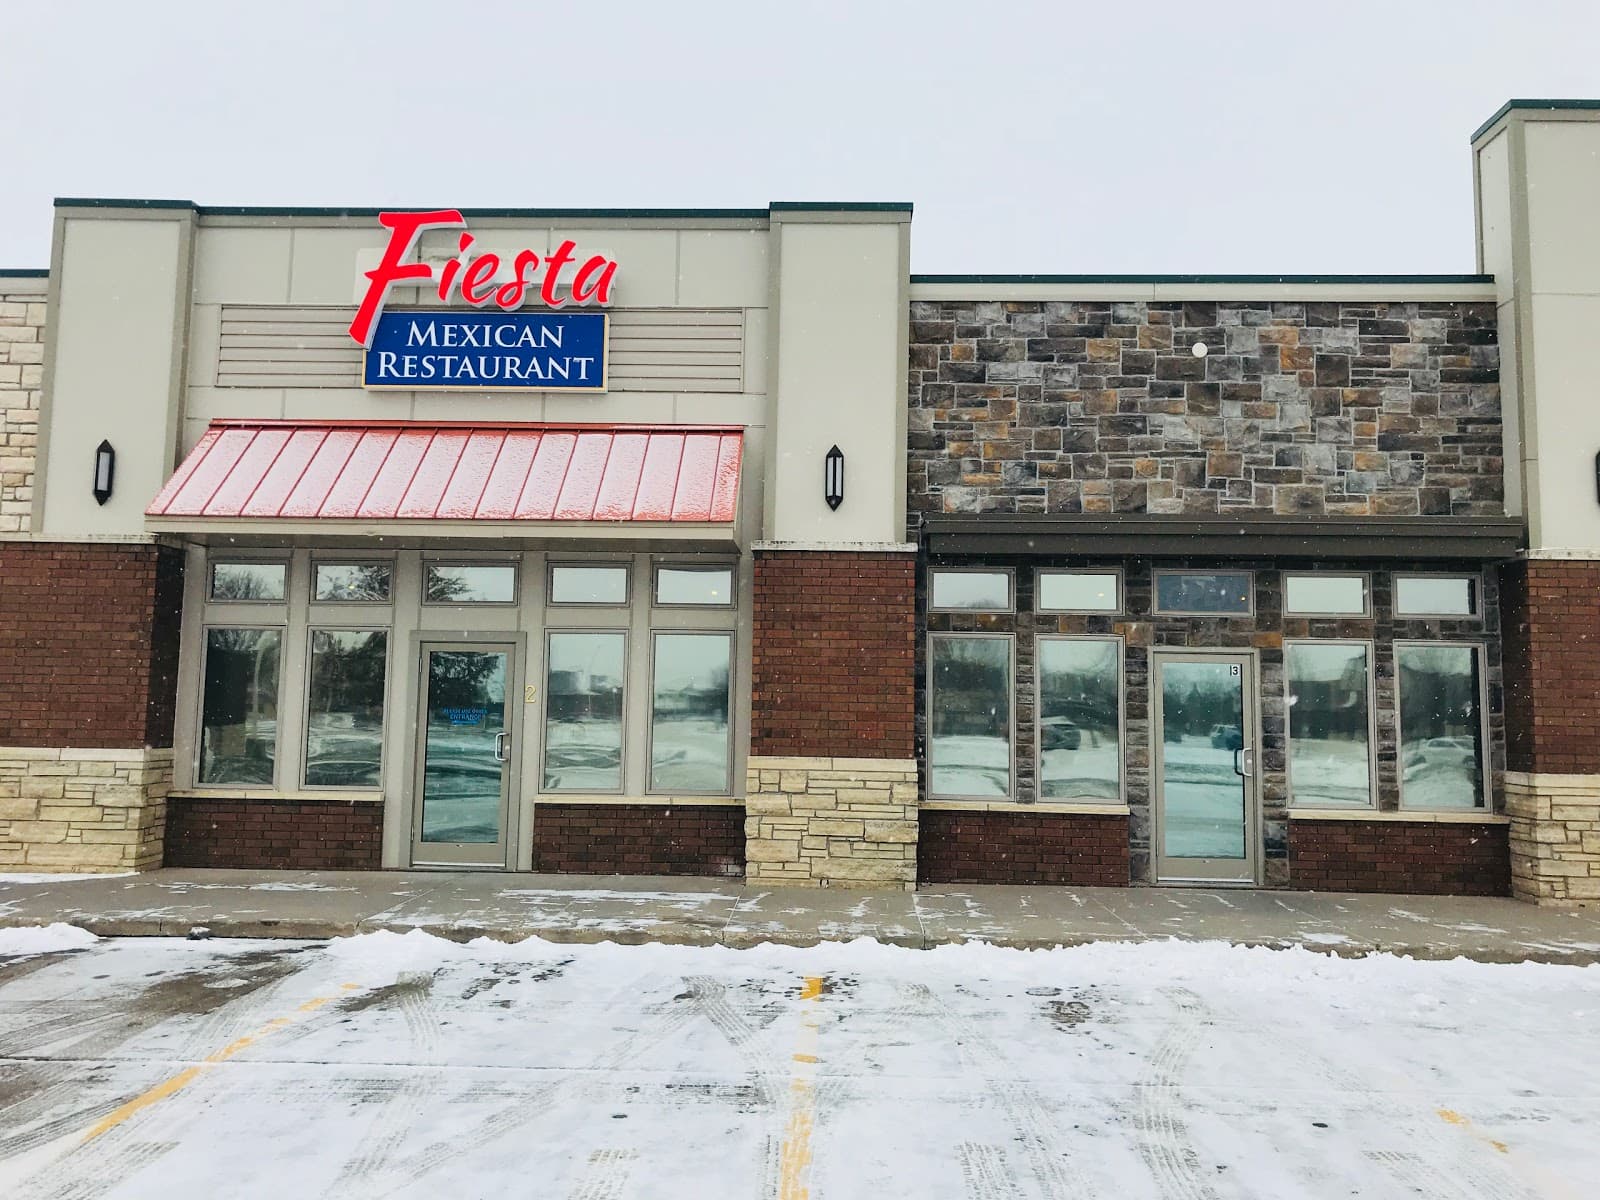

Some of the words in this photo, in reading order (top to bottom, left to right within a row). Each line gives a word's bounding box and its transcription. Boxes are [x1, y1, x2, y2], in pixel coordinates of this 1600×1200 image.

[348, 209, 618, 349] Fiesta
[406, 320, 565, 349] MEXICAN
[377, 351, 594, 380] RESTAURANT
[525, 684, 536, 703] 2
[449, 713, 481, 721] ENTRANCE
